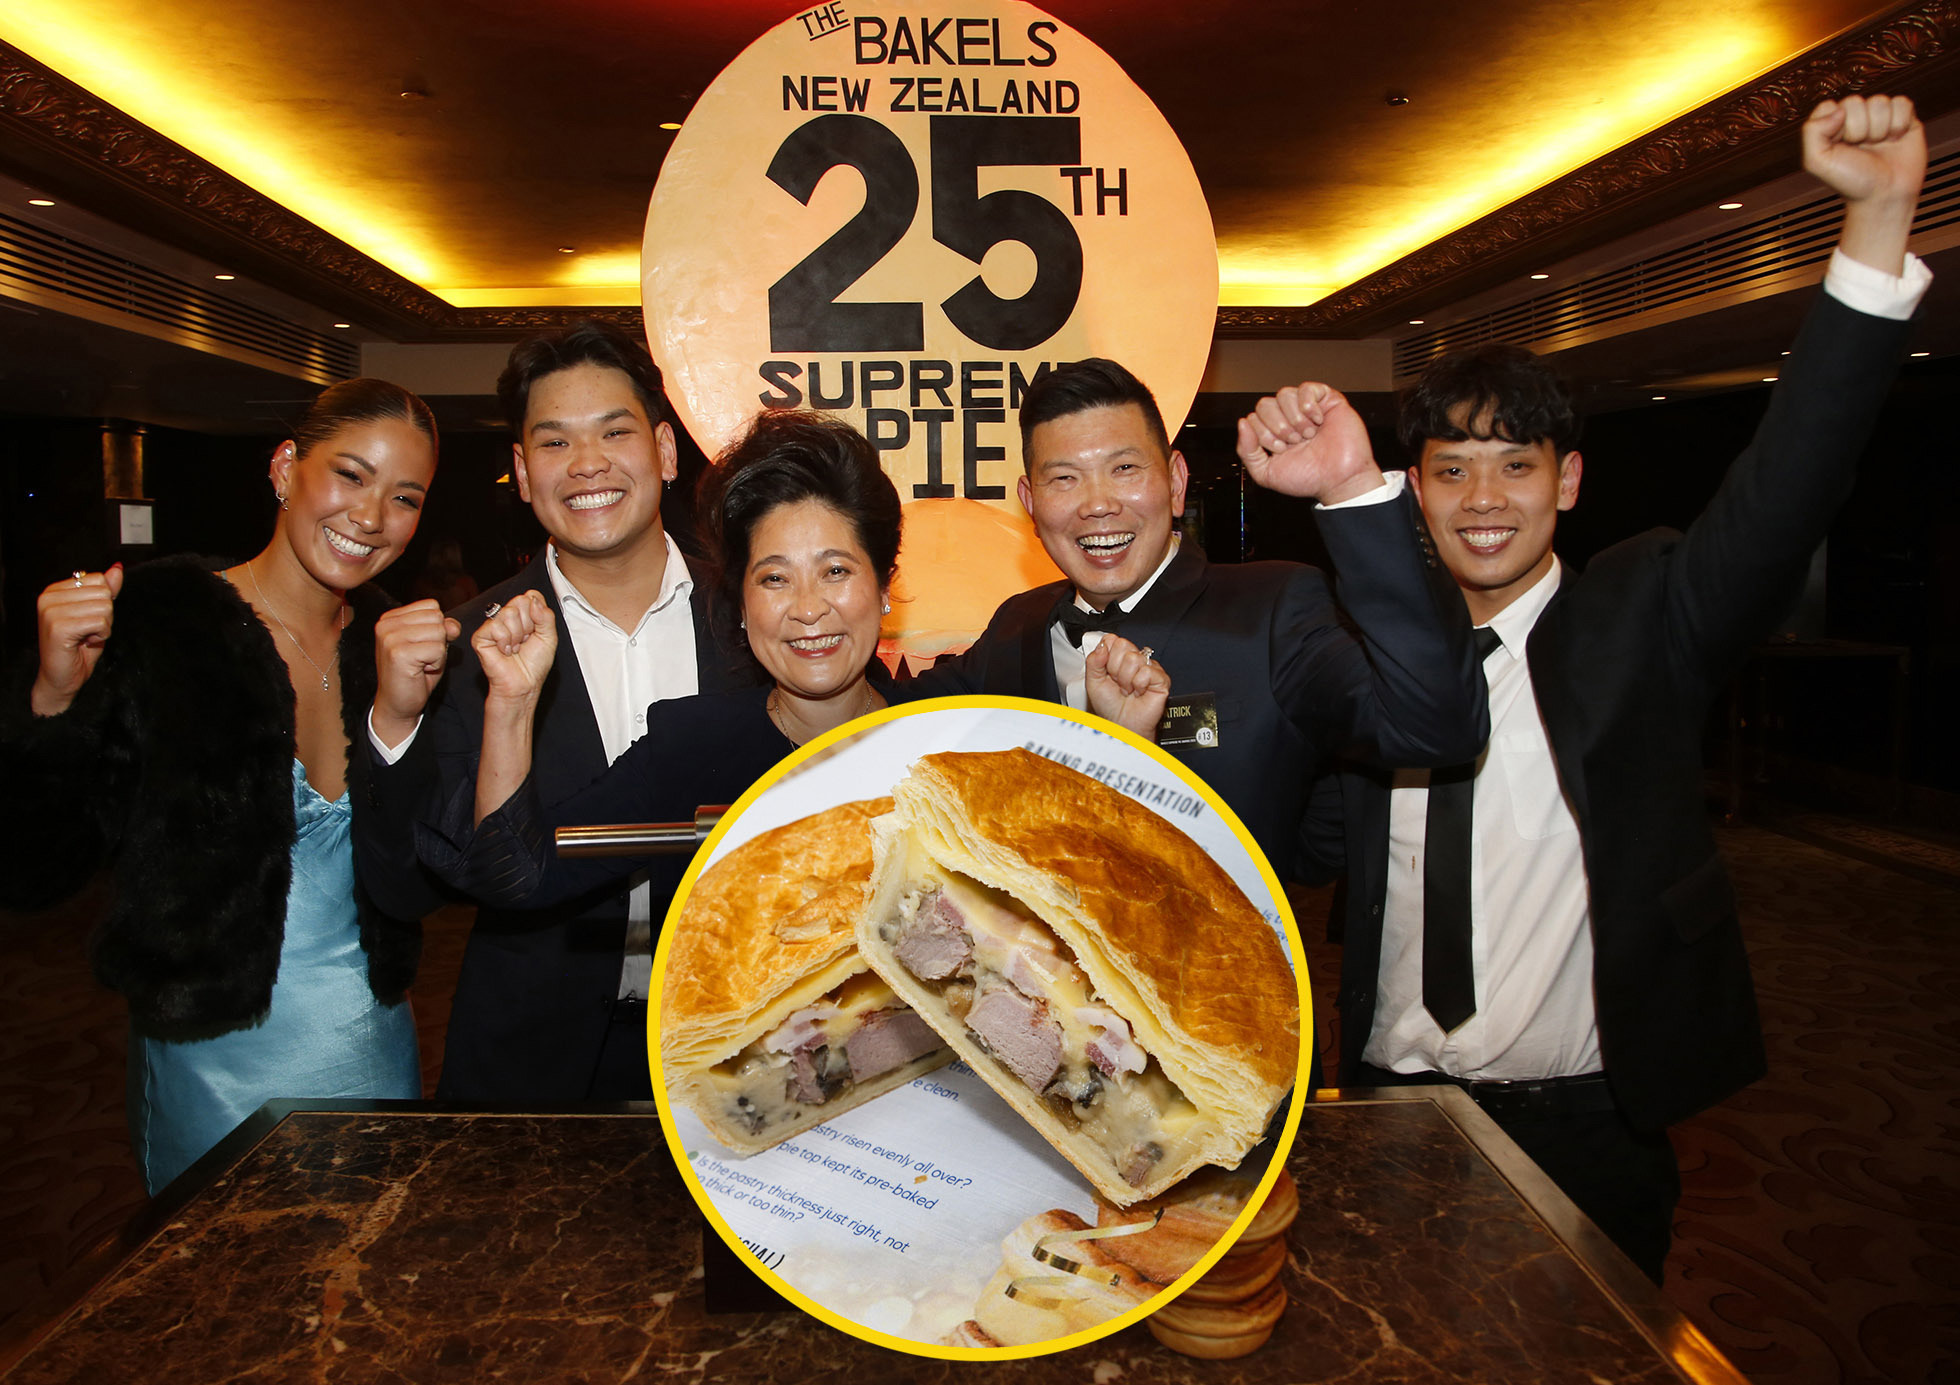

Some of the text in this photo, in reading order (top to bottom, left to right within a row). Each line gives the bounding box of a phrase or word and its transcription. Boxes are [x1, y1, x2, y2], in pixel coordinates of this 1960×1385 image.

[796, 1, 1059, 67] THE BAKELS
[782, 75, 1080, 114] NEW ZEALAND
[759, 360, 1080, 409] SUPREM
[866, 408, 1006, 500] PIE
[1167, 705, 1192, 718] TRICK
[1202, 731, 1211, 741] 13
[1083, 761, 1206, 818] PRESENTATION
[923, 1082, 959, 1102] clean.
[776, 1141, 939, 1210] pie top kept its pre-baked
[841, 1134, 872, 1151] risen
[872, 1146, 914, 1168] evenly
[914, 1161, 934, 1174] all
[932, 1168, 972, 1190] over?
[705, 1177, 736, 1196] thick
[734, 1190, 750, 1201] or
[748, 1196, 771, 1211] too
[770, 1204, 805, 1223] thin?
[708, 1161, 730, 1176] the
[726, 1170, 770, 1193] pastry
[768, 1185, 824, 1214] thickness
[819, 1207, 850, 1226] just
[847, 1219, 882, 1243] right,
[883, 1234, 911, 1253] not
